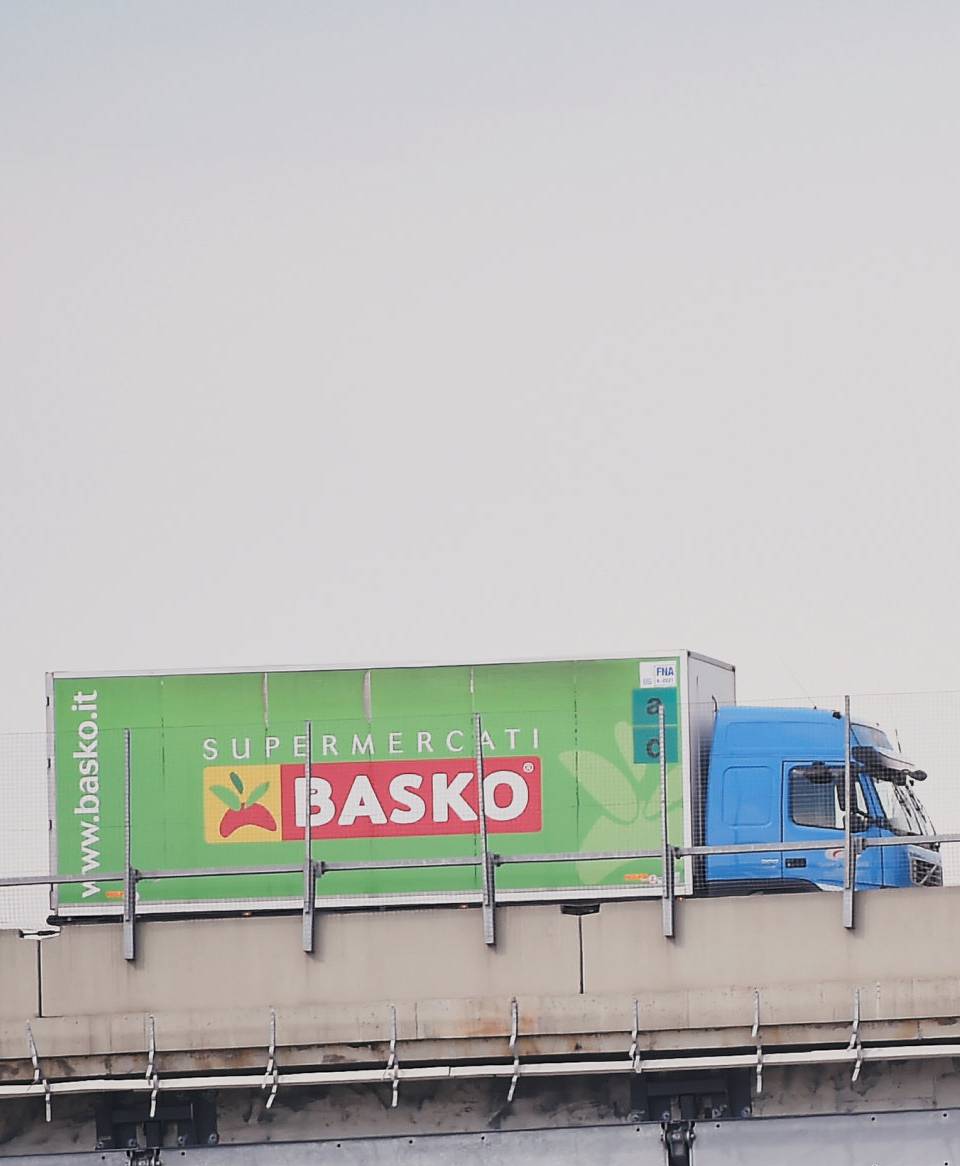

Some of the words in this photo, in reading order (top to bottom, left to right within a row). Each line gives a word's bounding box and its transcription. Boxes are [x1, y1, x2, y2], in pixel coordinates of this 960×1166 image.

[202, 728, 539, 760] SUPERMERCATI
[71, 689, 101, 898] www.basko.it
[294, 770, 530, 828] BASKO
